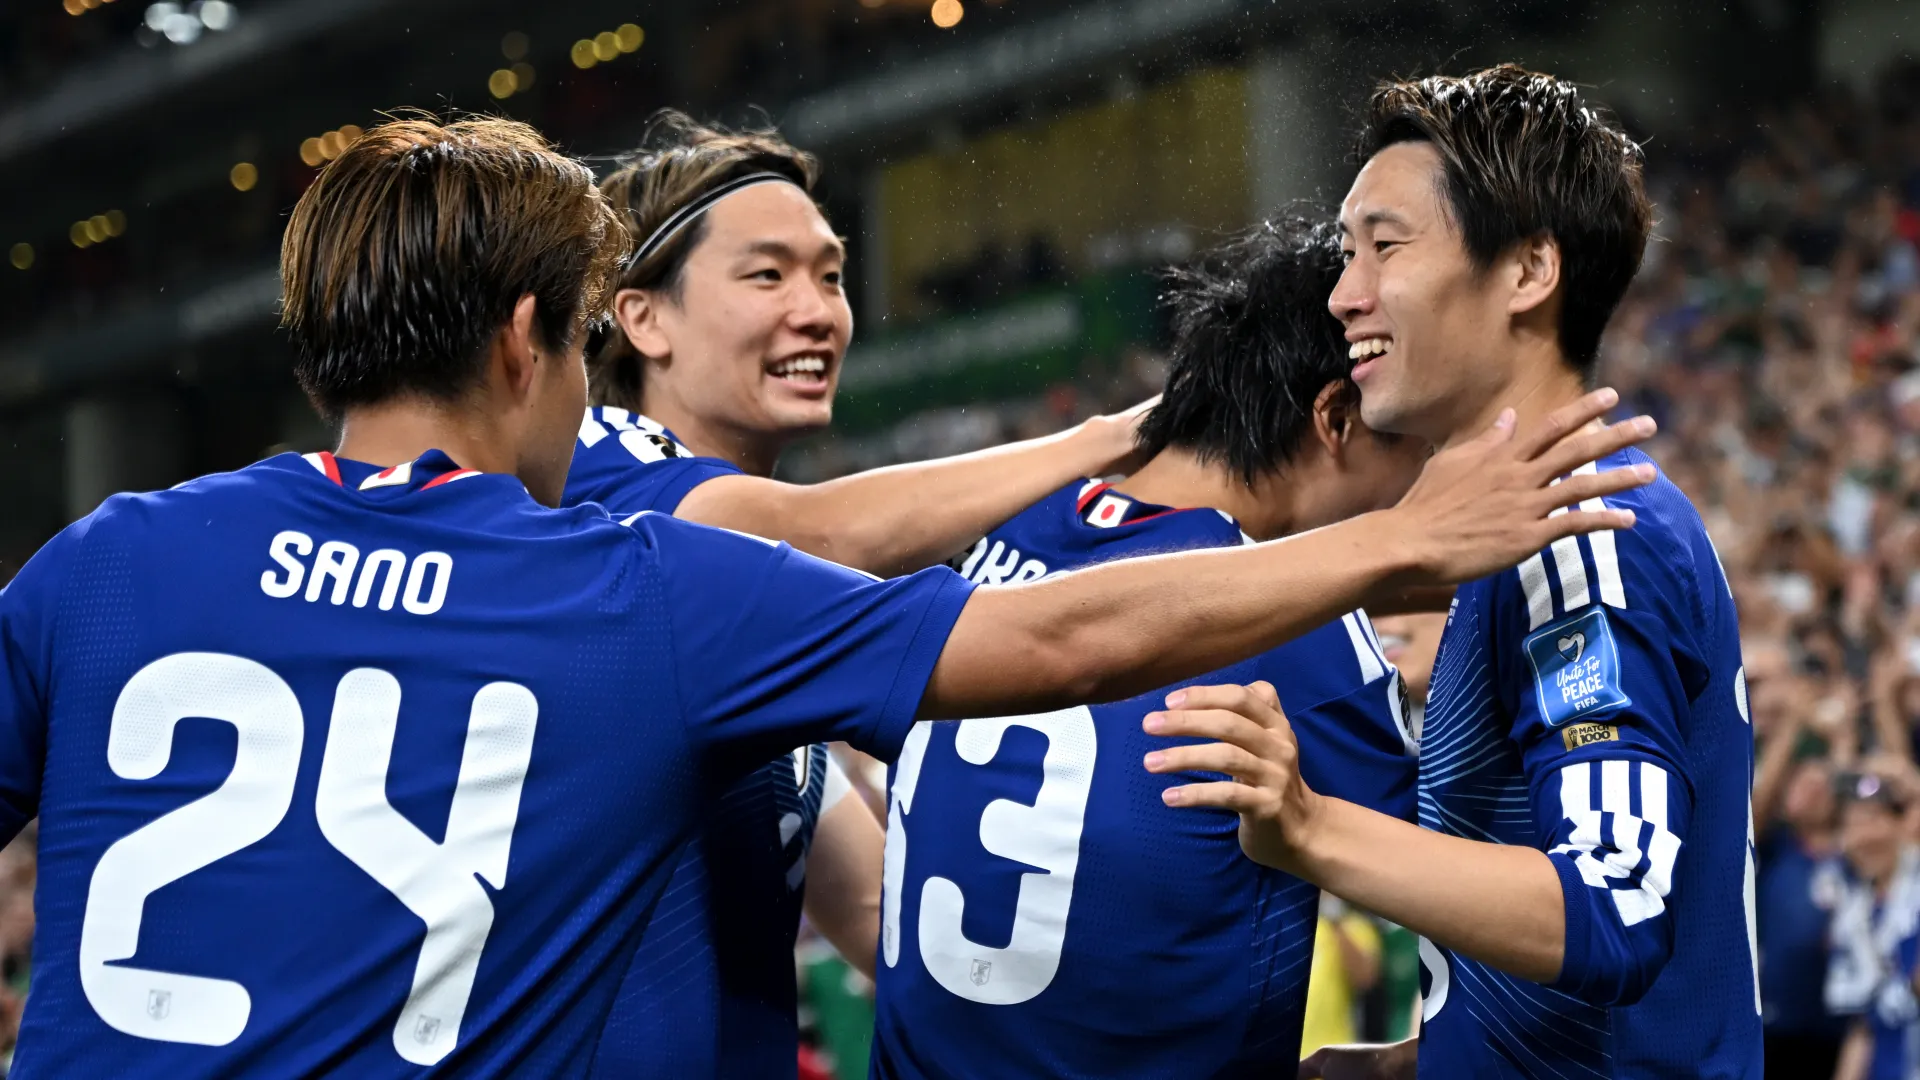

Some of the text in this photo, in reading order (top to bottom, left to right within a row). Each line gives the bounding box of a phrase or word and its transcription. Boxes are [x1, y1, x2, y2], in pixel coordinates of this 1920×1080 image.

[260, 530, 454, 616] SANO
[1556, 655, 1600, 688] Unite For
[1561, 672, 1604, 704] PEACE
[1574, 695, 1599, 711] FIFA
[1578, 724, 1610, 735] MATCH
[1580, 730, 1611, 744] 1000
[79, 651, 539, 1067] 24
